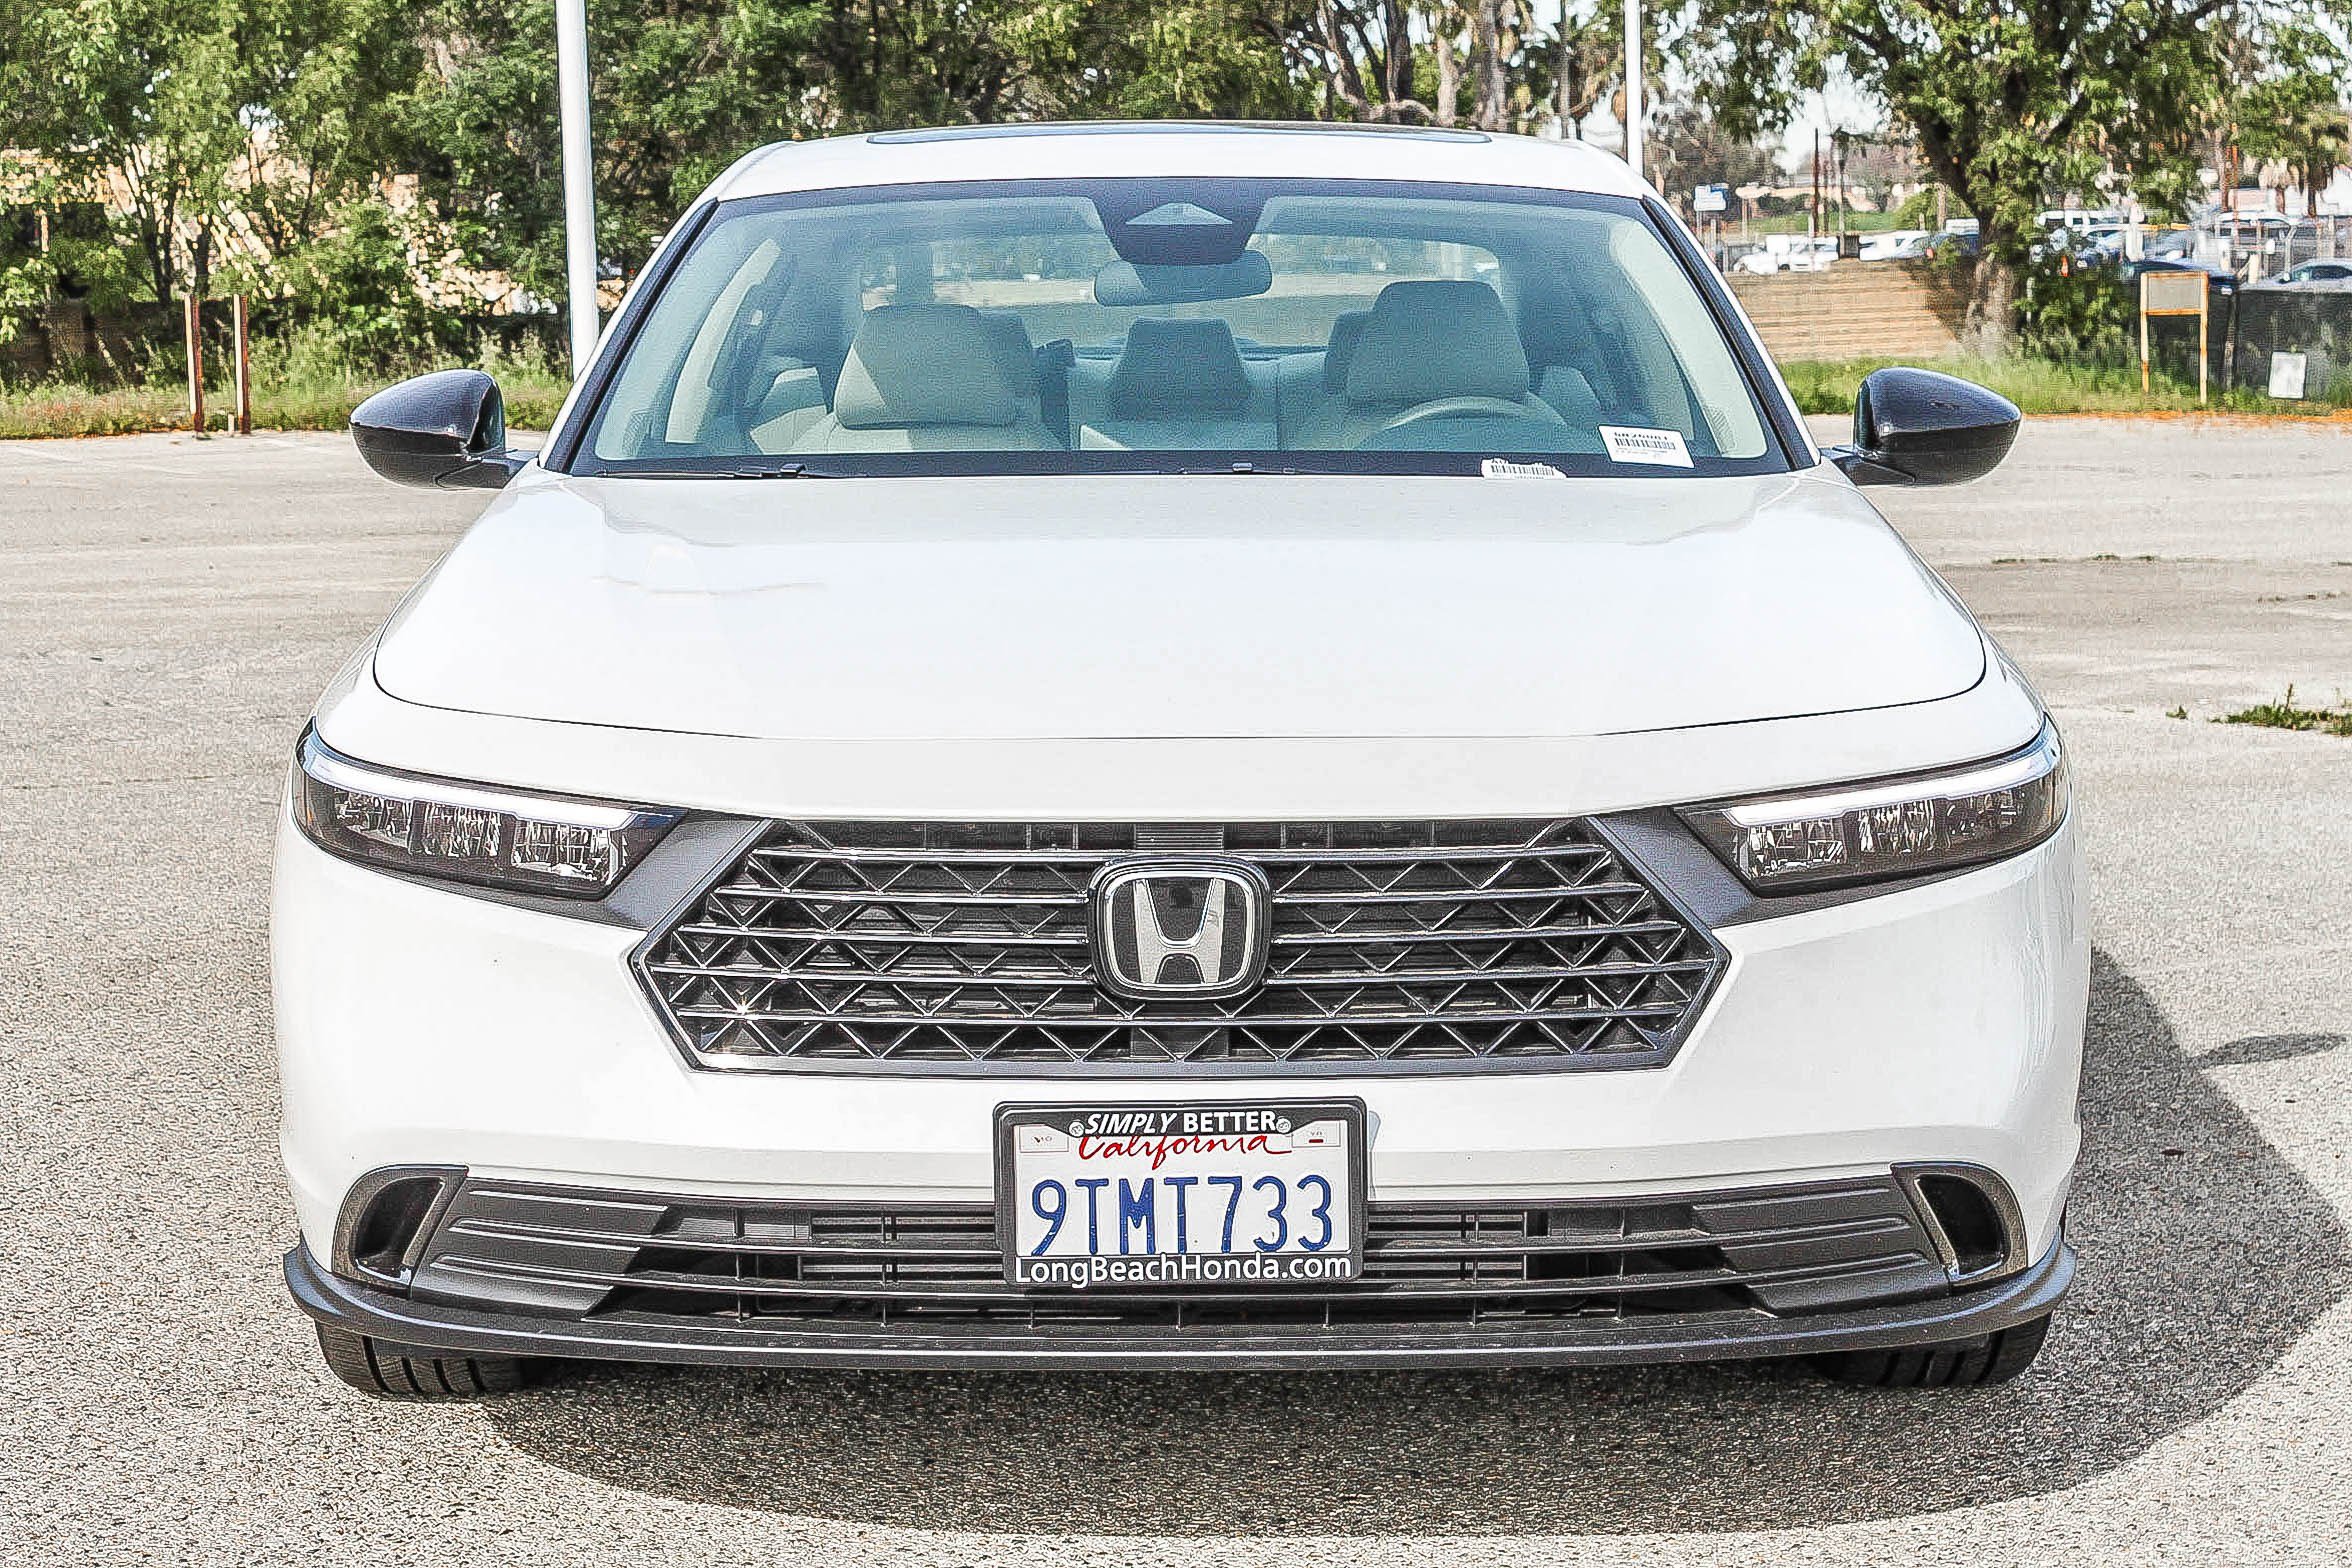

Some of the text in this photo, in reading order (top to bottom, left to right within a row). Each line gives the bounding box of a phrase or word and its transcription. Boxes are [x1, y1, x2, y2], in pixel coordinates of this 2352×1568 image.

[1084, 1111, 1276, 1135] SIMPLY BETTER
[1078, 1134, 1292, 1170] California
[1031, 1174, 1333, 1256] 9TMT733
[1015, 1252, 1352, 1288] LongBeachHonda.com
